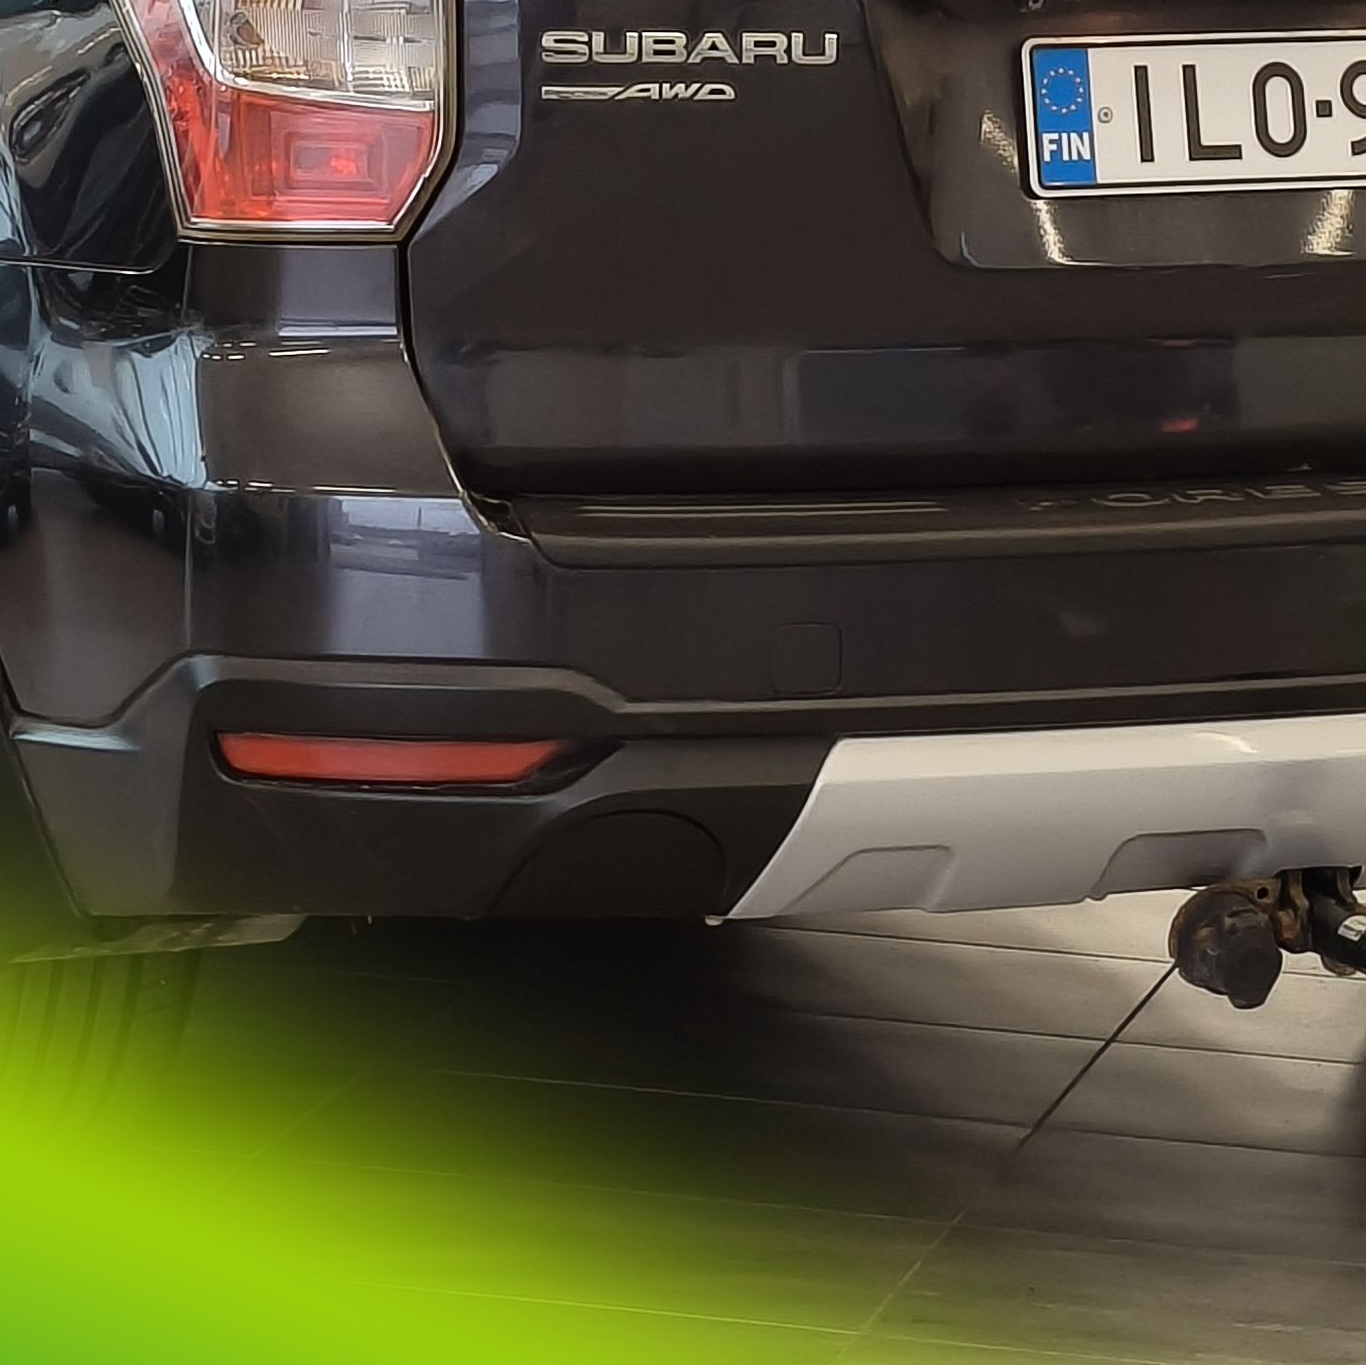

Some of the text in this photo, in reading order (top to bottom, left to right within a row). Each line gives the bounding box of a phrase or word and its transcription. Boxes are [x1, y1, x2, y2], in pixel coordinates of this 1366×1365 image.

[540, 30, 839, 65] SUBARU
[613, 82, 737, 101] AWD
[1041, 131, 1092, 163] FIN
